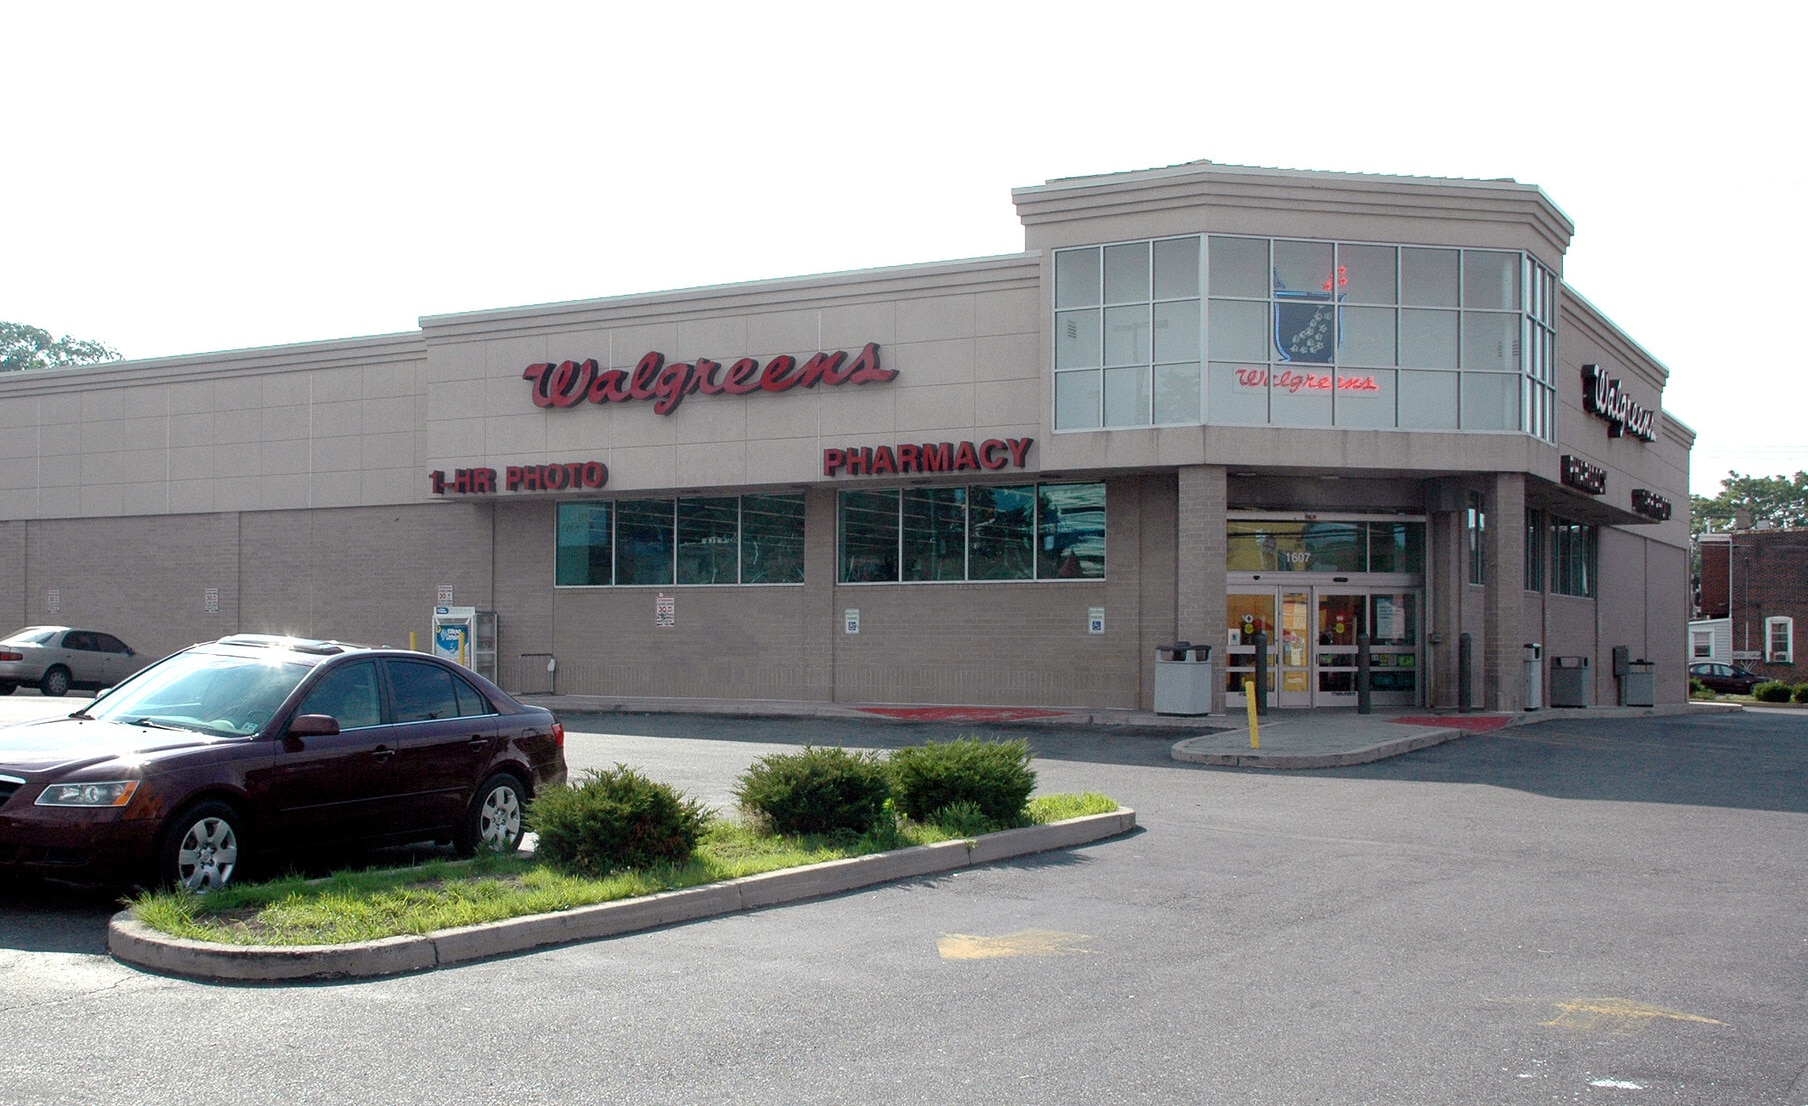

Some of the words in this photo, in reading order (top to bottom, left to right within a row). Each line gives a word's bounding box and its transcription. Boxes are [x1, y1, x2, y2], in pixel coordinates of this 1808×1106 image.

[523, 342, 899, 416] Walgreens
[1235, 367, 1380, 394] Walgreens
[823, 437, 1034, 477] PHARMACY
[428, 467, 497, 495] 1-HR
[505, 460, 609, 491] PHOTO
[1286, 552, 1310, 563] 1607
